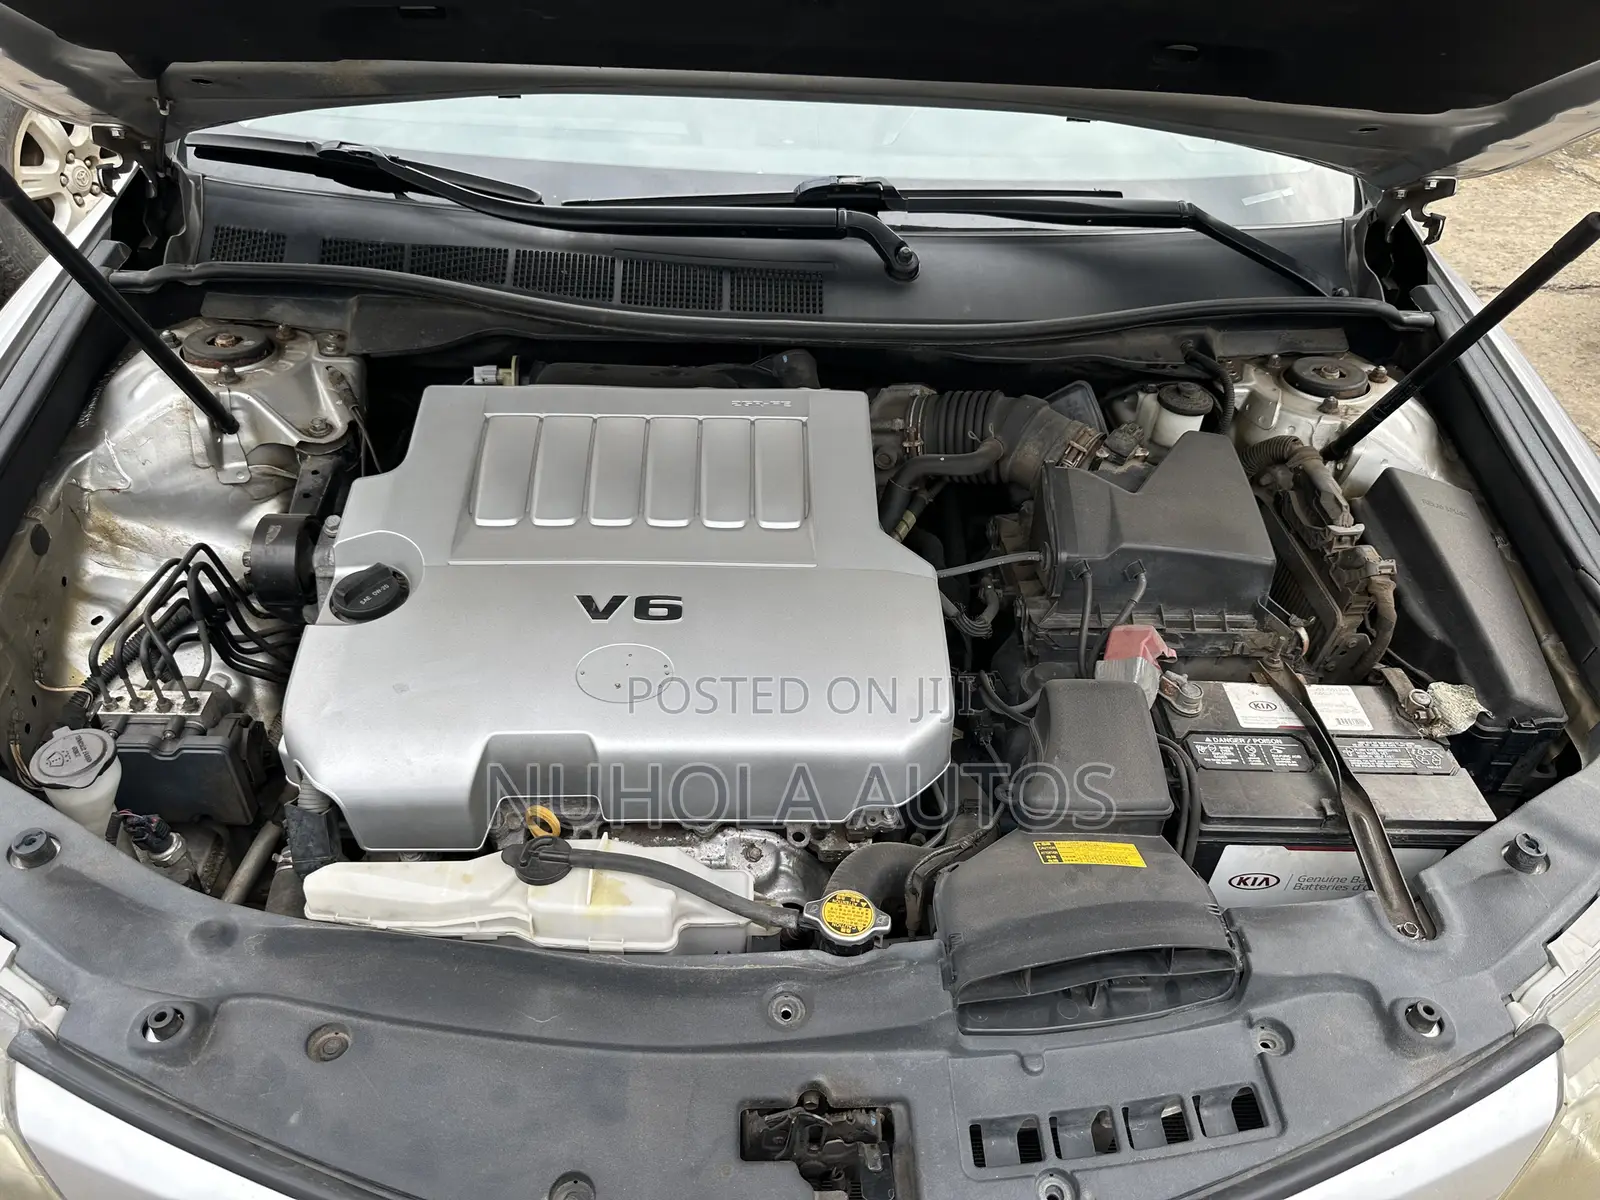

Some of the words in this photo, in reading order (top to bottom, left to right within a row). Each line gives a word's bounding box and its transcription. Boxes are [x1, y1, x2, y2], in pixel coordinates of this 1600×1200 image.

[574, 594, 684, 624] V6
[1297, 874, 1348, 884] Genuine
[1350, 875, 1367, 884] Ba
[1293, 882, 1349, 891] Batteries
